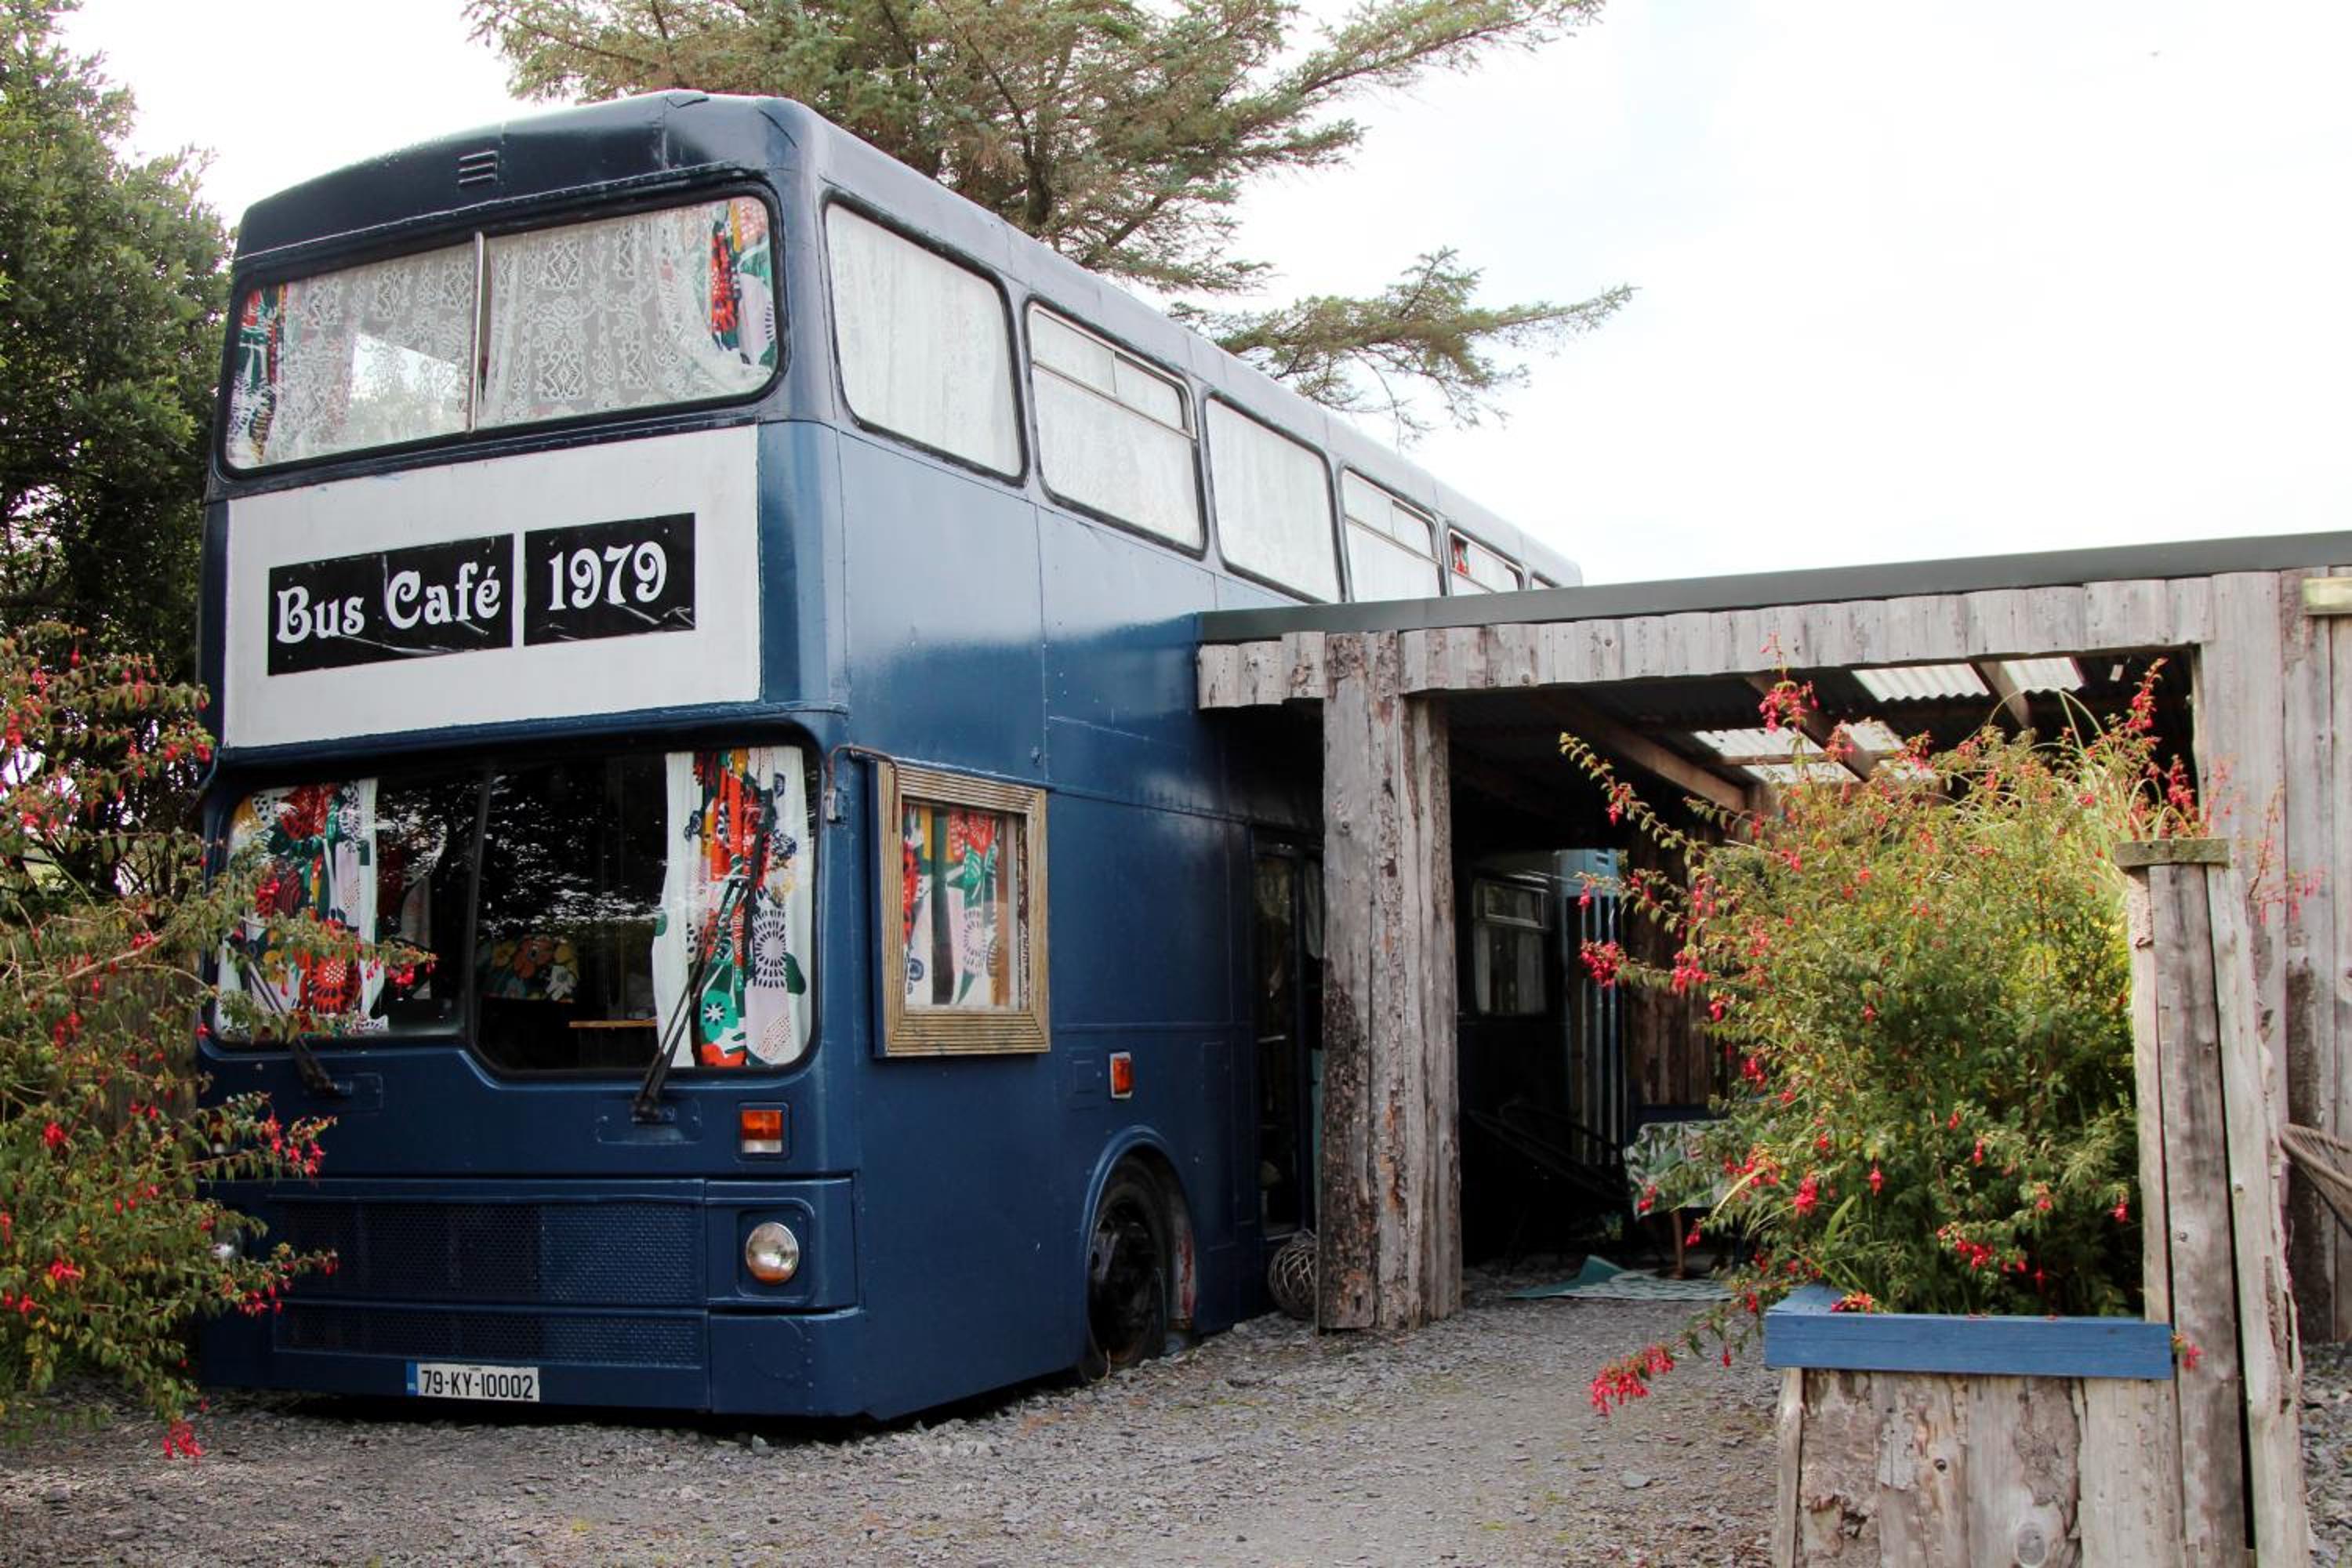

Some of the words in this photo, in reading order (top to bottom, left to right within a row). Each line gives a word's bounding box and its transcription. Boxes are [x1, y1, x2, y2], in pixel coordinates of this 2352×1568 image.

[276, 585, 365, 644] Bus
[387, 561, 502, 630] Café
[548, 541, 667, 611] 1979
[422, 1370, 534, 1399] 79-KY-10002
